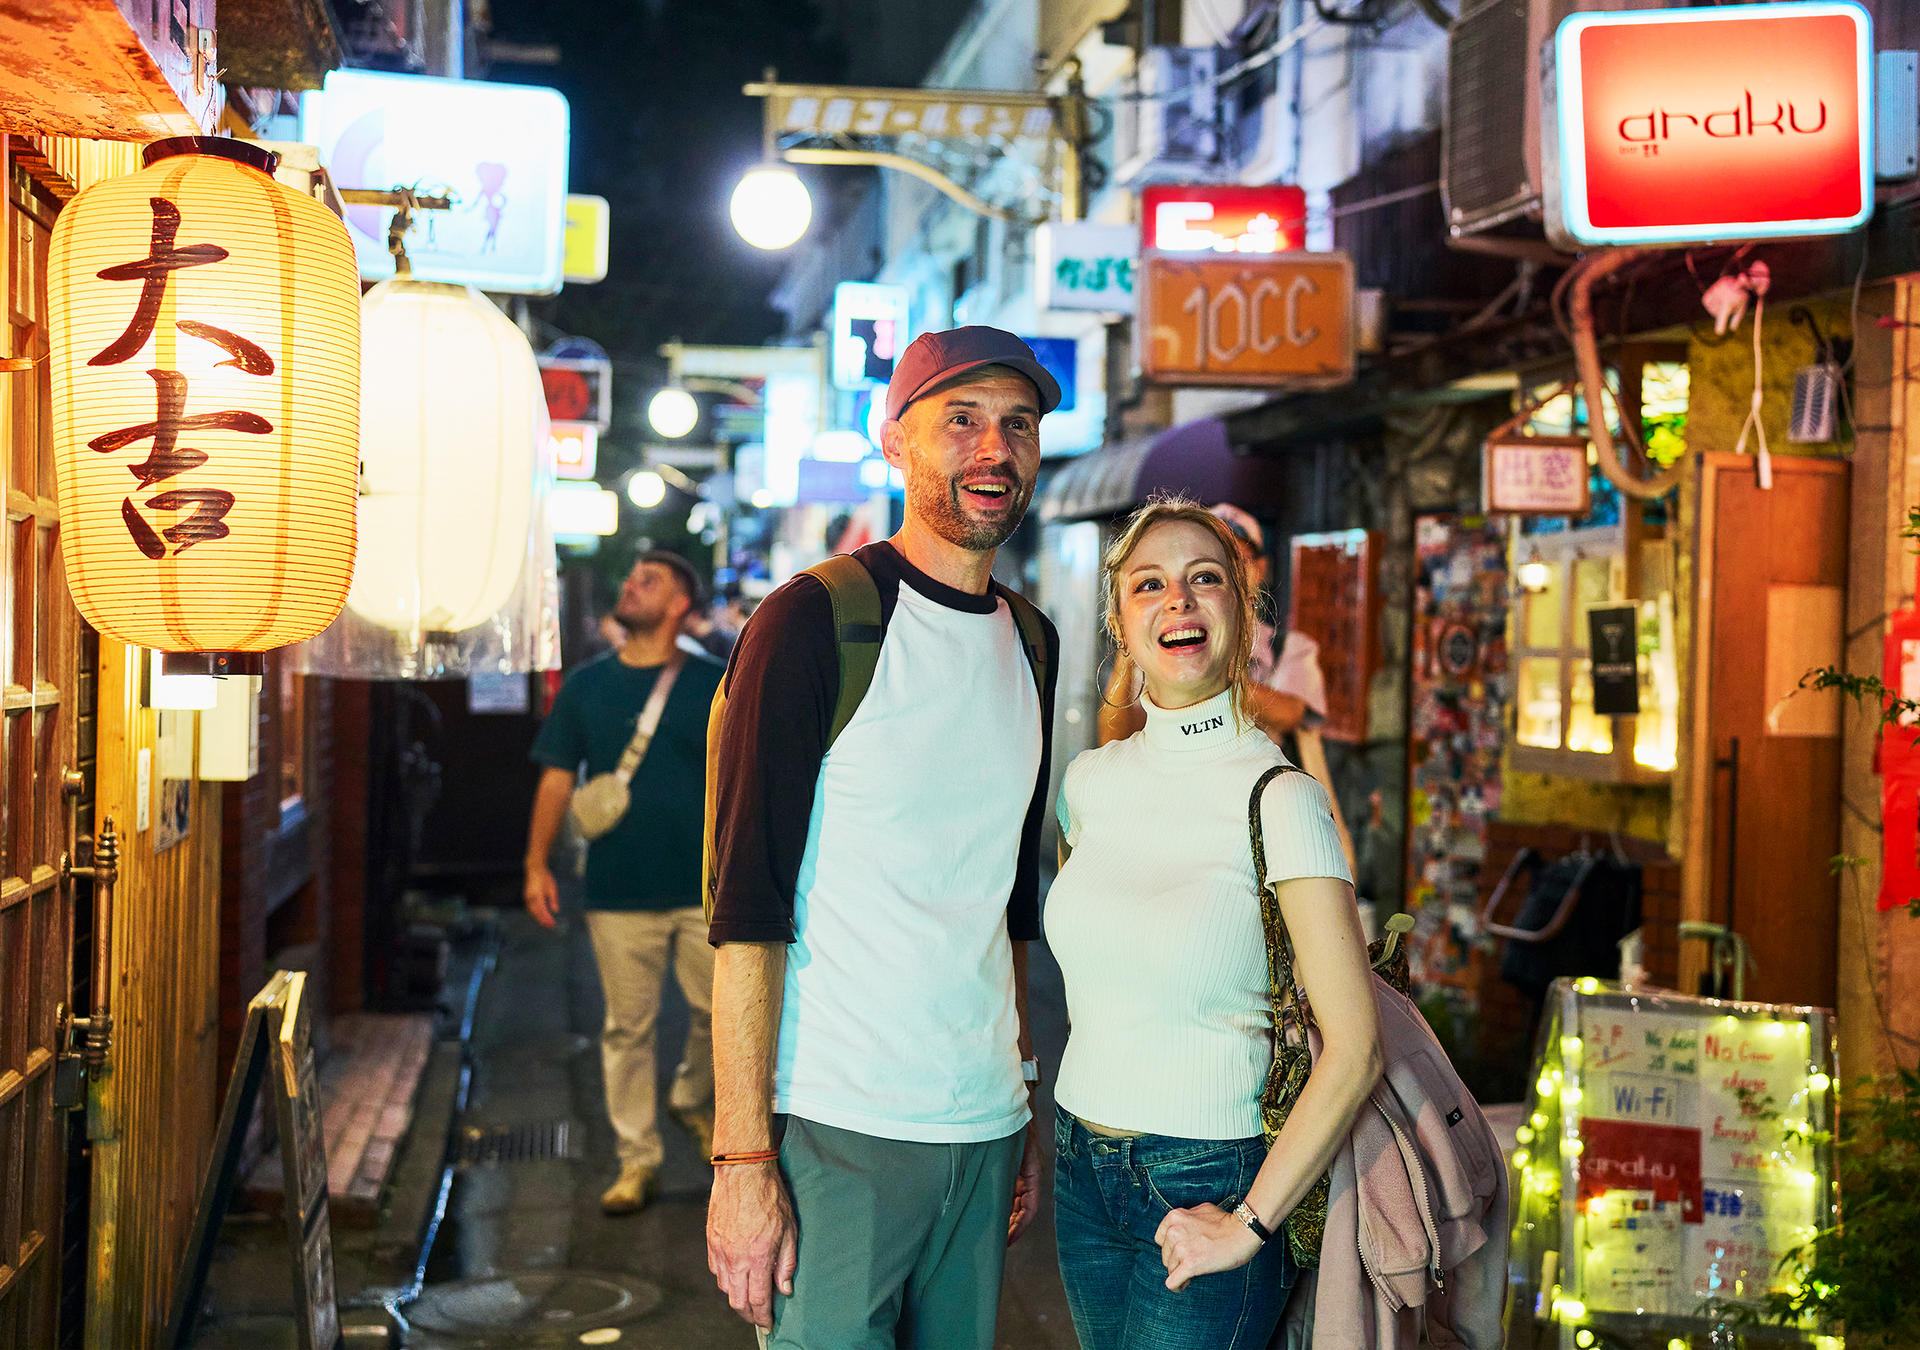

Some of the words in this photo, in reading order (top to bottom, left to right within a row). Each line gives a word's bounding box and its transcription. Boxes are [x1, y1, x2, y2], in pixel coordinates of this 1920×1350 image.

[1618, 89, 1827, 142] araku
[86, 197, 275, 560] 大吉
[1180, 715, 1224, 736] VLTN
